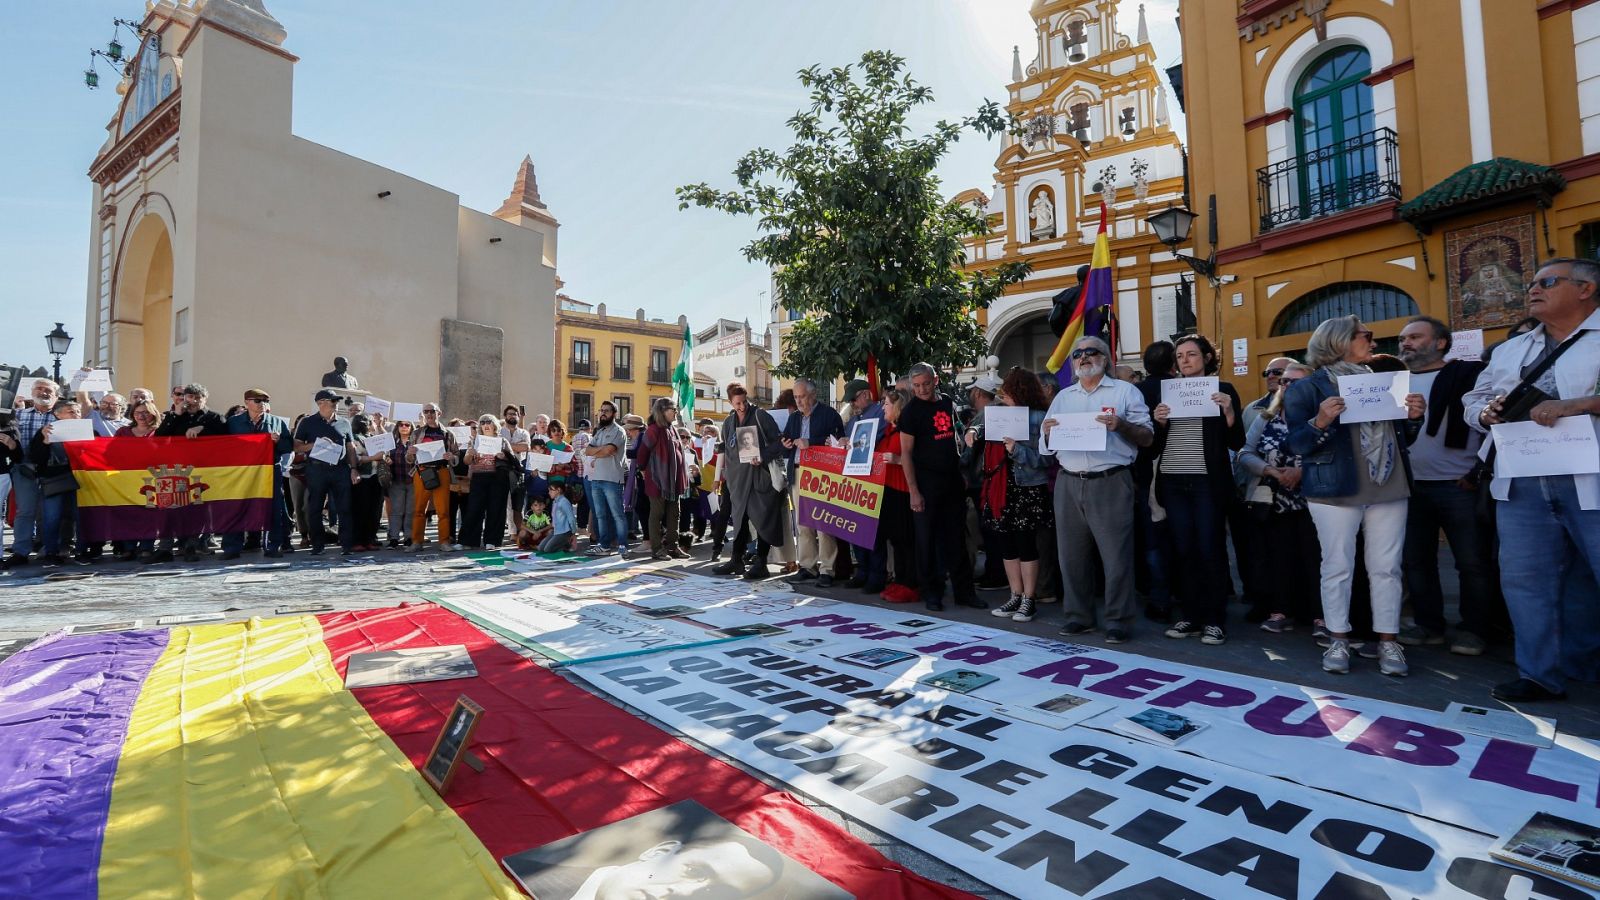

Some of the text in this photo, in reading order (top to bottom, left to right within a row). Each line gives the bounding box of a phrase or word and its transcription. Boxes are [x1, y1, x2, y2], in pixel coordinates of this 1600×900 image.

[811, 506, 857, 533] Utrera
[600, 666, 682, 694] LA
[723, 647, 915, 709] FUERA
[913, 704, 1013, 742] EL
[773, 613, 920, 641] por
[1018, 656, 1600, 808] REPÚBL
[669, 655, 902, 738] QUEIPO
[895, 737, 1049, 796] DE
[1046, 787, 1420, 900] LLA
